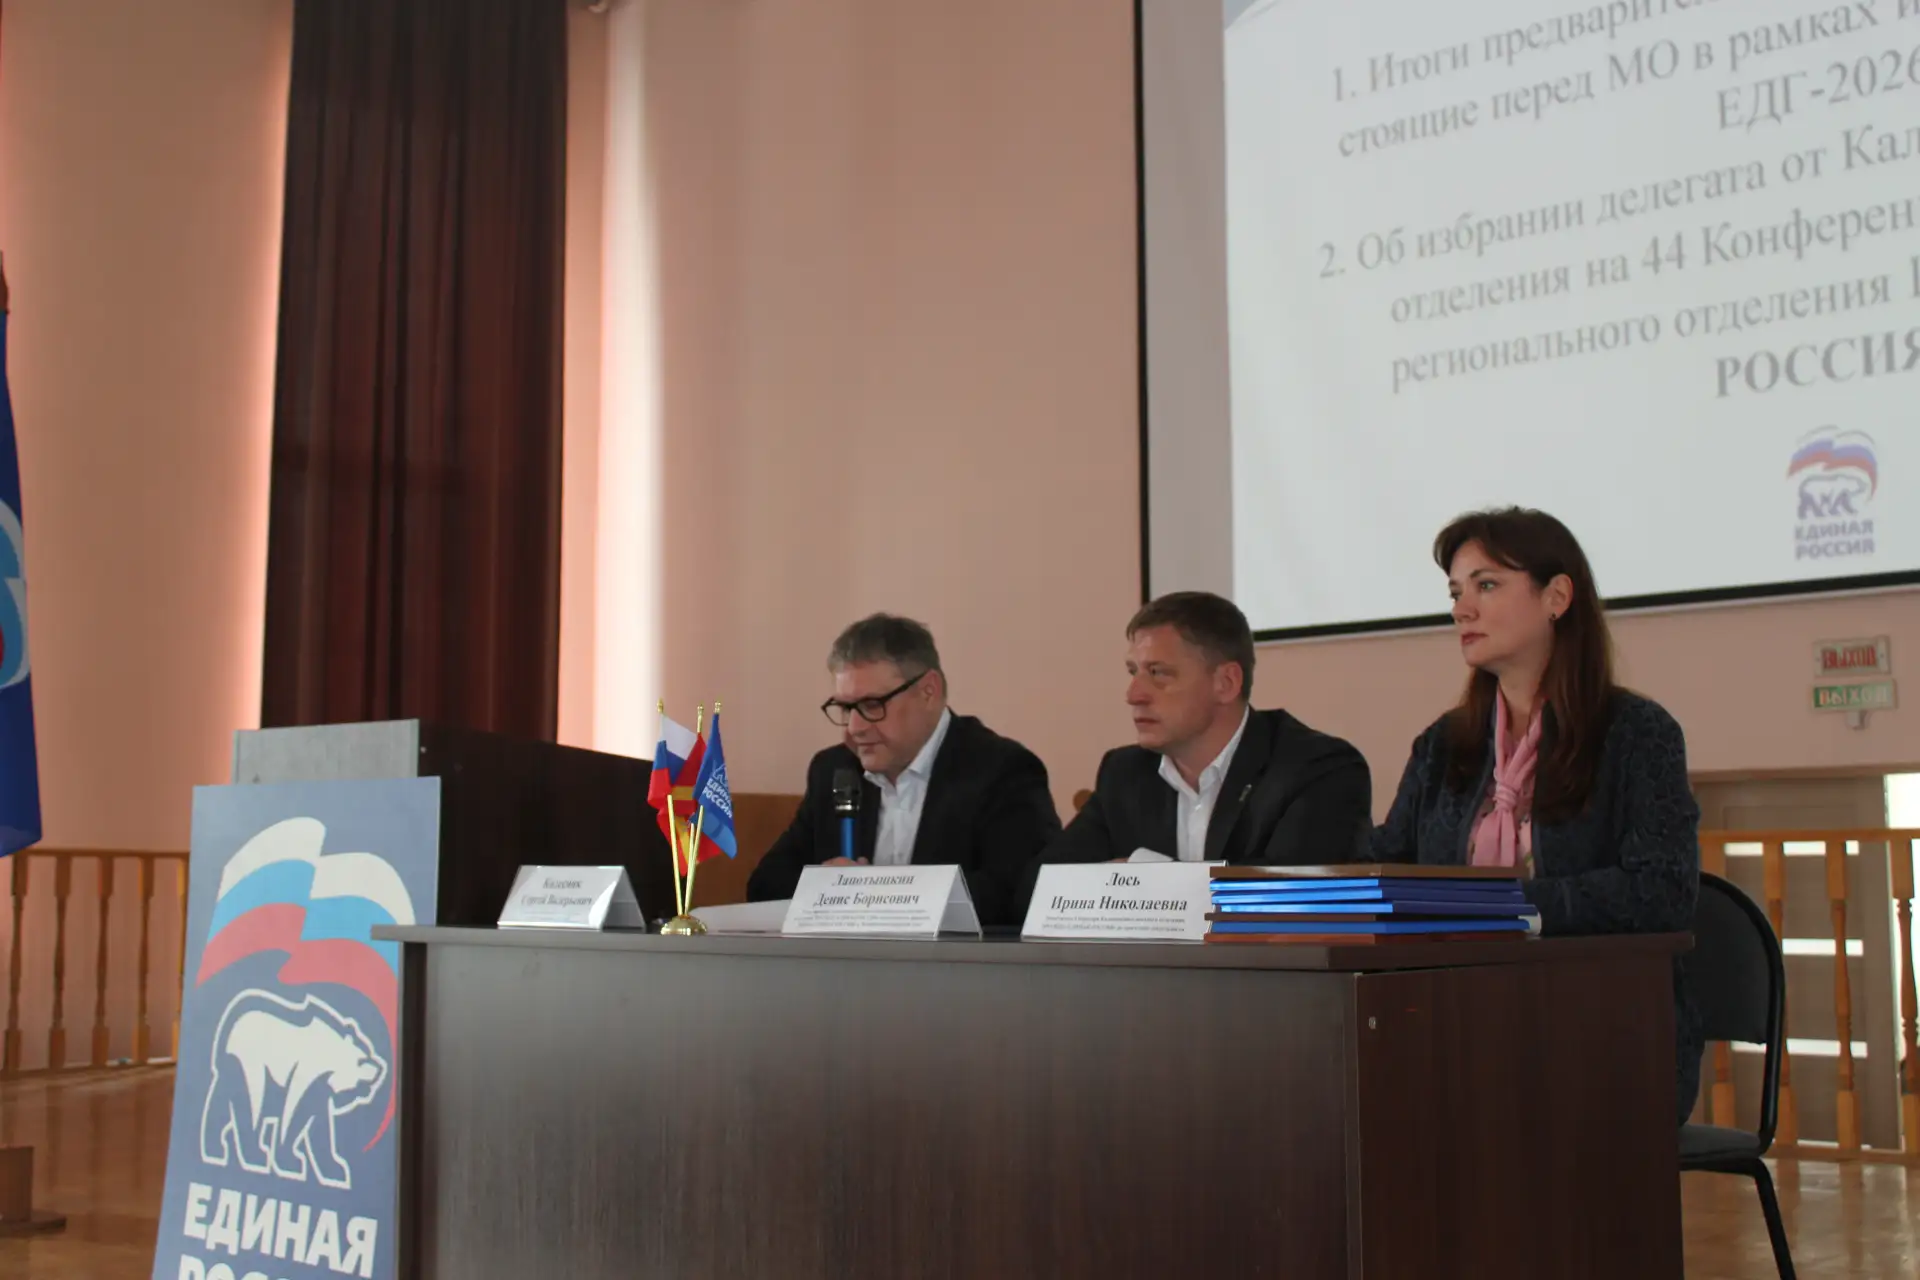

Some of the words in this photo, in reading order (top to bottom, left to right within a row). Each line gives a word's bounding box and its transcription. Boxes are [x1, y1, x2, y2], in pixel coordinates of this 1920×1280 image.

[1333, 66, 1357, 101] 1.
[1368, 43, 1470, 93] Итоги
[1481, 0, 1704, 67] предвари
[1338, 100, 1479, 157] стоящие
[1491, 71, 1596, 120] перед
[1607, 39, 1680, 92] МО
[1693, 41, 1714, 71] в
[1727, 0, 1880, 72] рамках
[1716, 44, 1920, 132] ЕДГ-2026
[1318, 241, 1346, 279] 2.
[1356, 226, 1405, 270] Об
[1415, 199, 1585, 257] избрании
[1596, 160, 1766, 225] делегата
[1781, 146, 1828, 183] от
[1841, 123, 1920, 171] Кал
[1390, 265, 1571, 323] отделения
[1586, 253, 1630, 287] на
[1641, 231, 1687, 275] 44
[1391, 314, 1661, 394] регионального
[1674, 273, 1891, 338] отделения
[1715, 326, 1920, 398] РОССИЯ
[1795, 538, 1875, 561] РОССИЯ
[813, 893, 850, 908] Денис
[853, 892, 920, 908] Борисович
[1051, 895, 1095, 913] Ирина
[1098, 895, 1188, 912] Николаевна
[1105, 872, 1141, 887] Лось
[183, 1181, 379, 1279] ЕДИНАЯ
